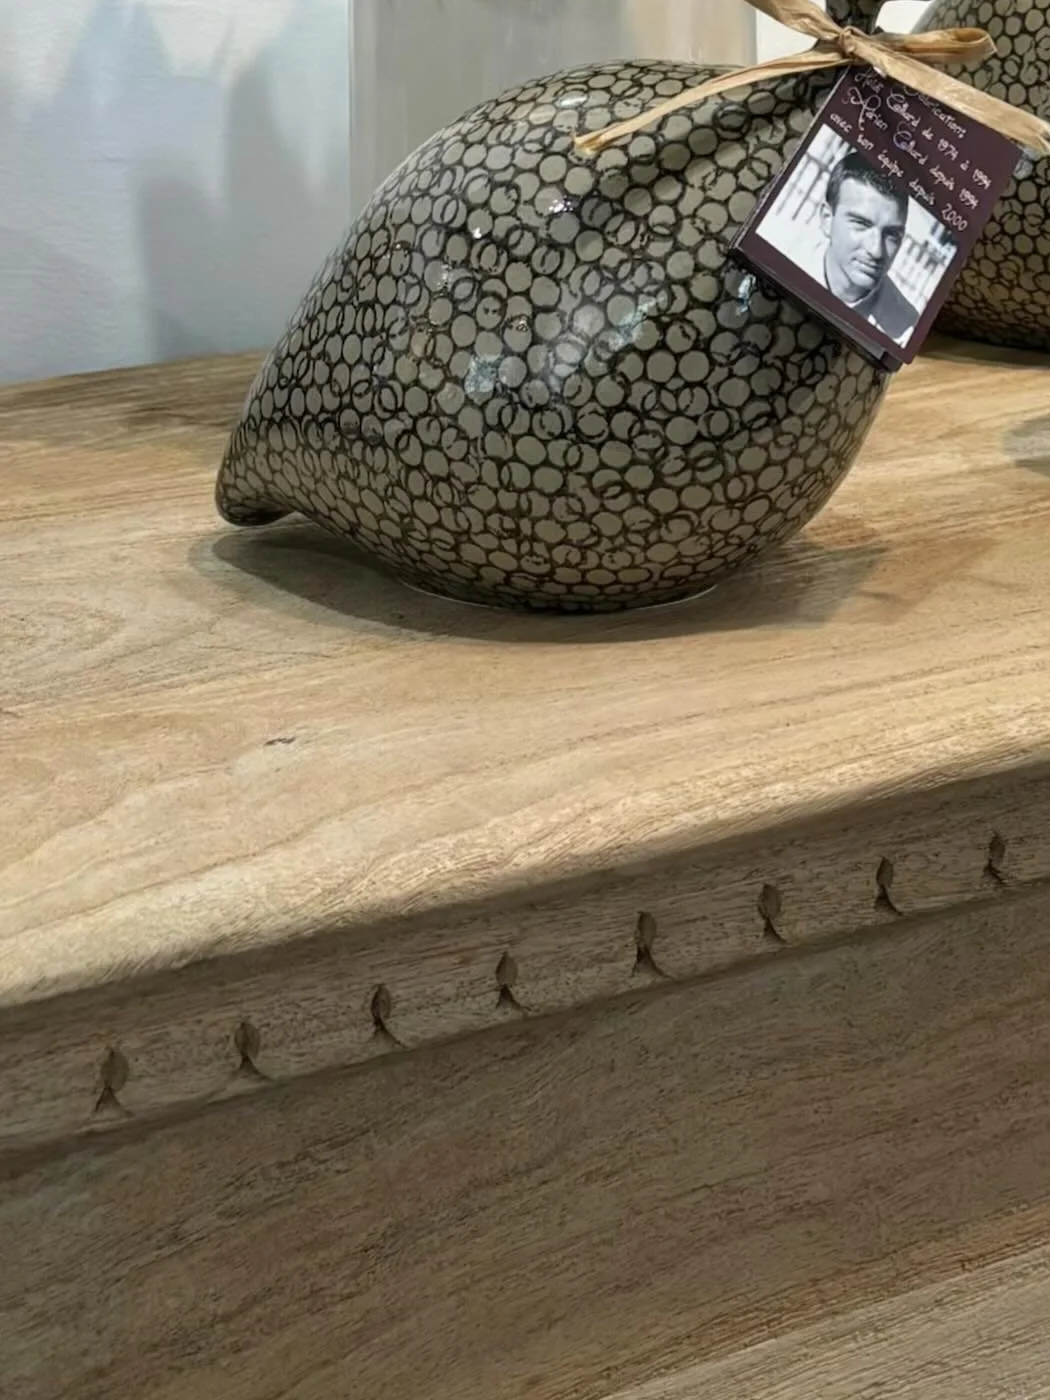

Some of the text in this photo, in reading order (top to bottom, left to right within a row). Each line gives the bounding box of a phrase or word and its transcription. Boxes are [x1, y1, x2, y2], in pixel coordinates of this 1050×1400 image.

[829, 112, 853, 134] avec
[856, 132, 874, 151] son
[908, 177, 935, 206] depuis
[940, 203, 968, 232] 2000
[921, 125, 934, 141] de
[937, 137, 959, 161] 1974
[972, 168, 992, 190] 1994
[929, 164, 955, 192] depuis
[958, 187, 980, 210] 1994
